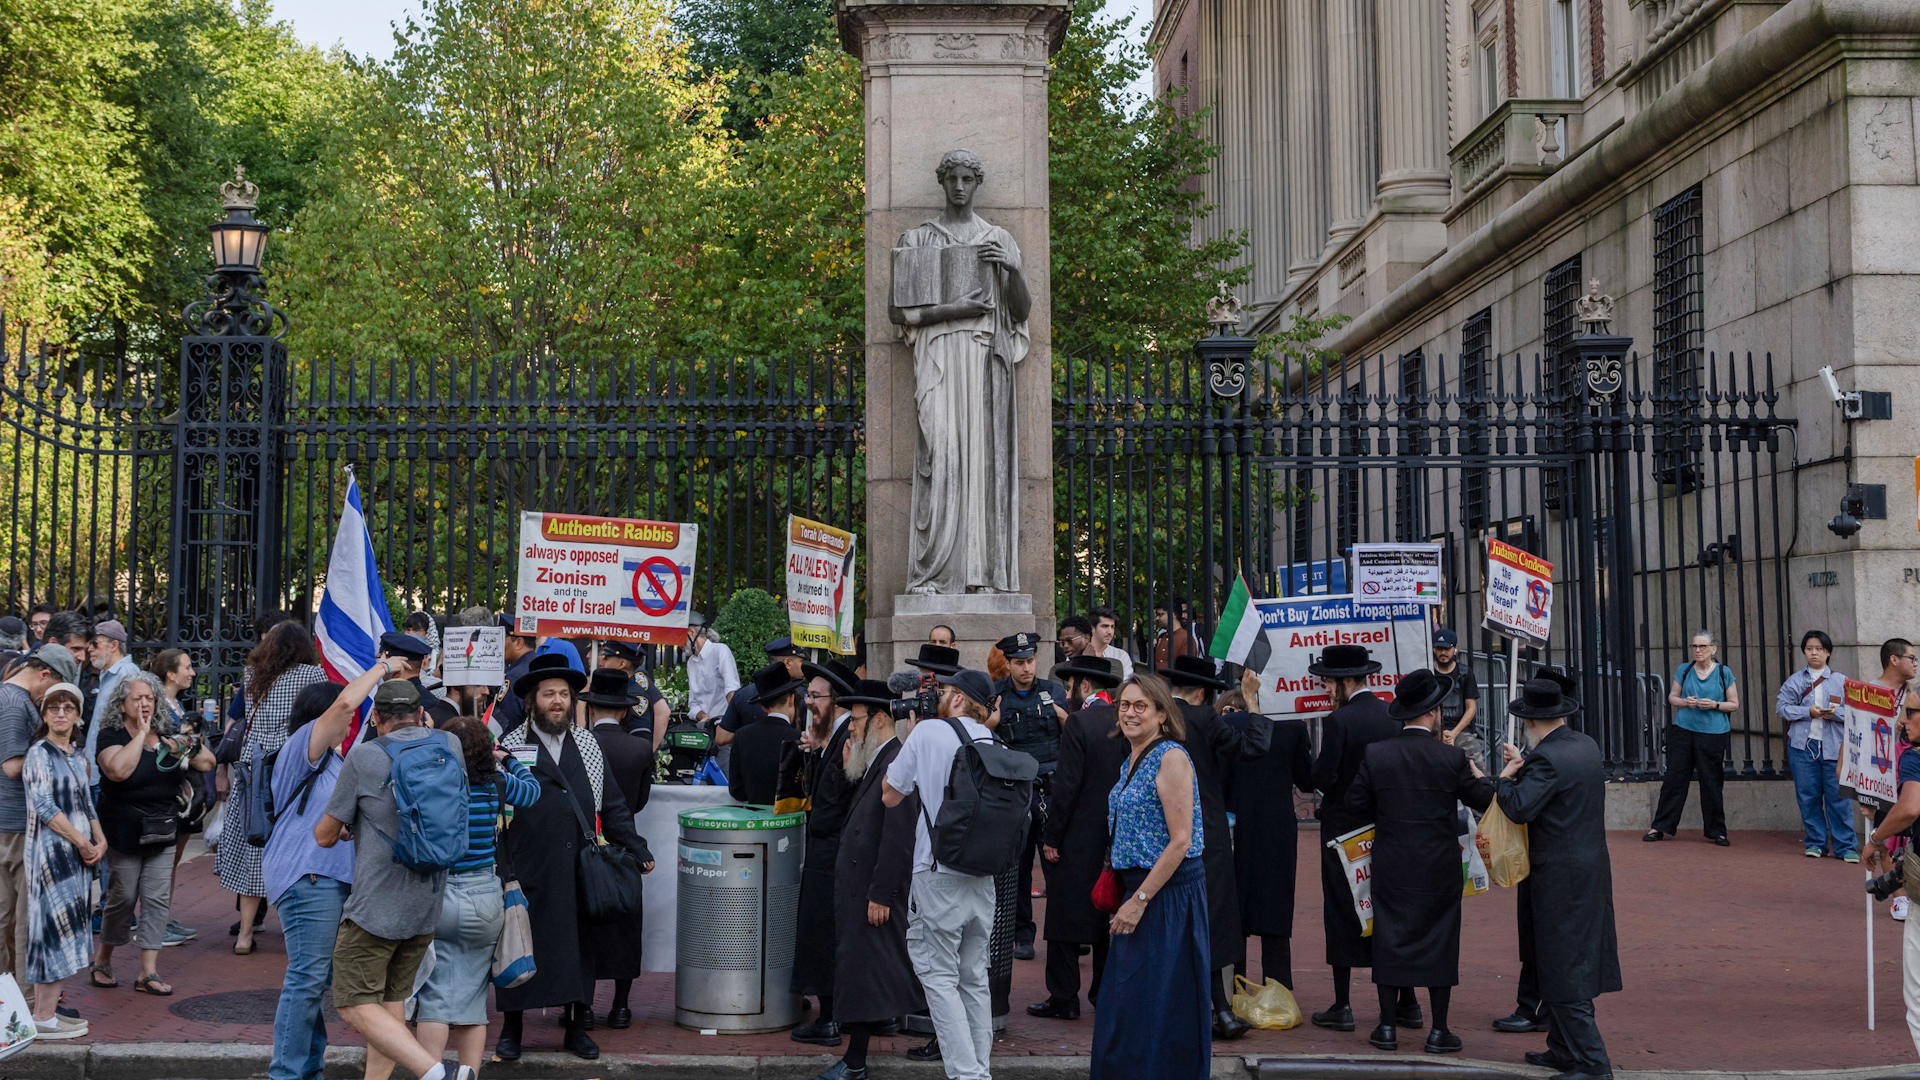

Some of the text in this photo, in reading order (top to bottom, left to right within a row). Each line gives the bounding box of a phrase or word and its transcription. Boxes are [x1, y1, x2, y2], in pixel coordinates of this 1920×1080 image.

[547, 517, 674, 543] Authentic Rabbis
[800, 524, 845, 550] Torah Demands
[525, 543, 619, 566] always opposed
[788, 553, 804, 575] ALL
[1490, 541, 1551, 578] Judaism Condemns
[536, 567, 607, 586] Zionism
[1502, 566, 1511, 580] the
[554, 587, 588, 597] and the
[1492, 577, 1519, 597] State of
[522, 595, 616, 616] State of Israel
[1257, 602, 1420, 626] Don't Buy Zionist Propaganda
[1490, 605, 1548, 637] And its Atrocities
[562, 625, 651, 641] www.NKUSA.org
[1289, 626, 1390, 648] Anti-Israel
[698, 817, 797, 828] Recycle Recycle
[696, 867, 728, 879] Paper
